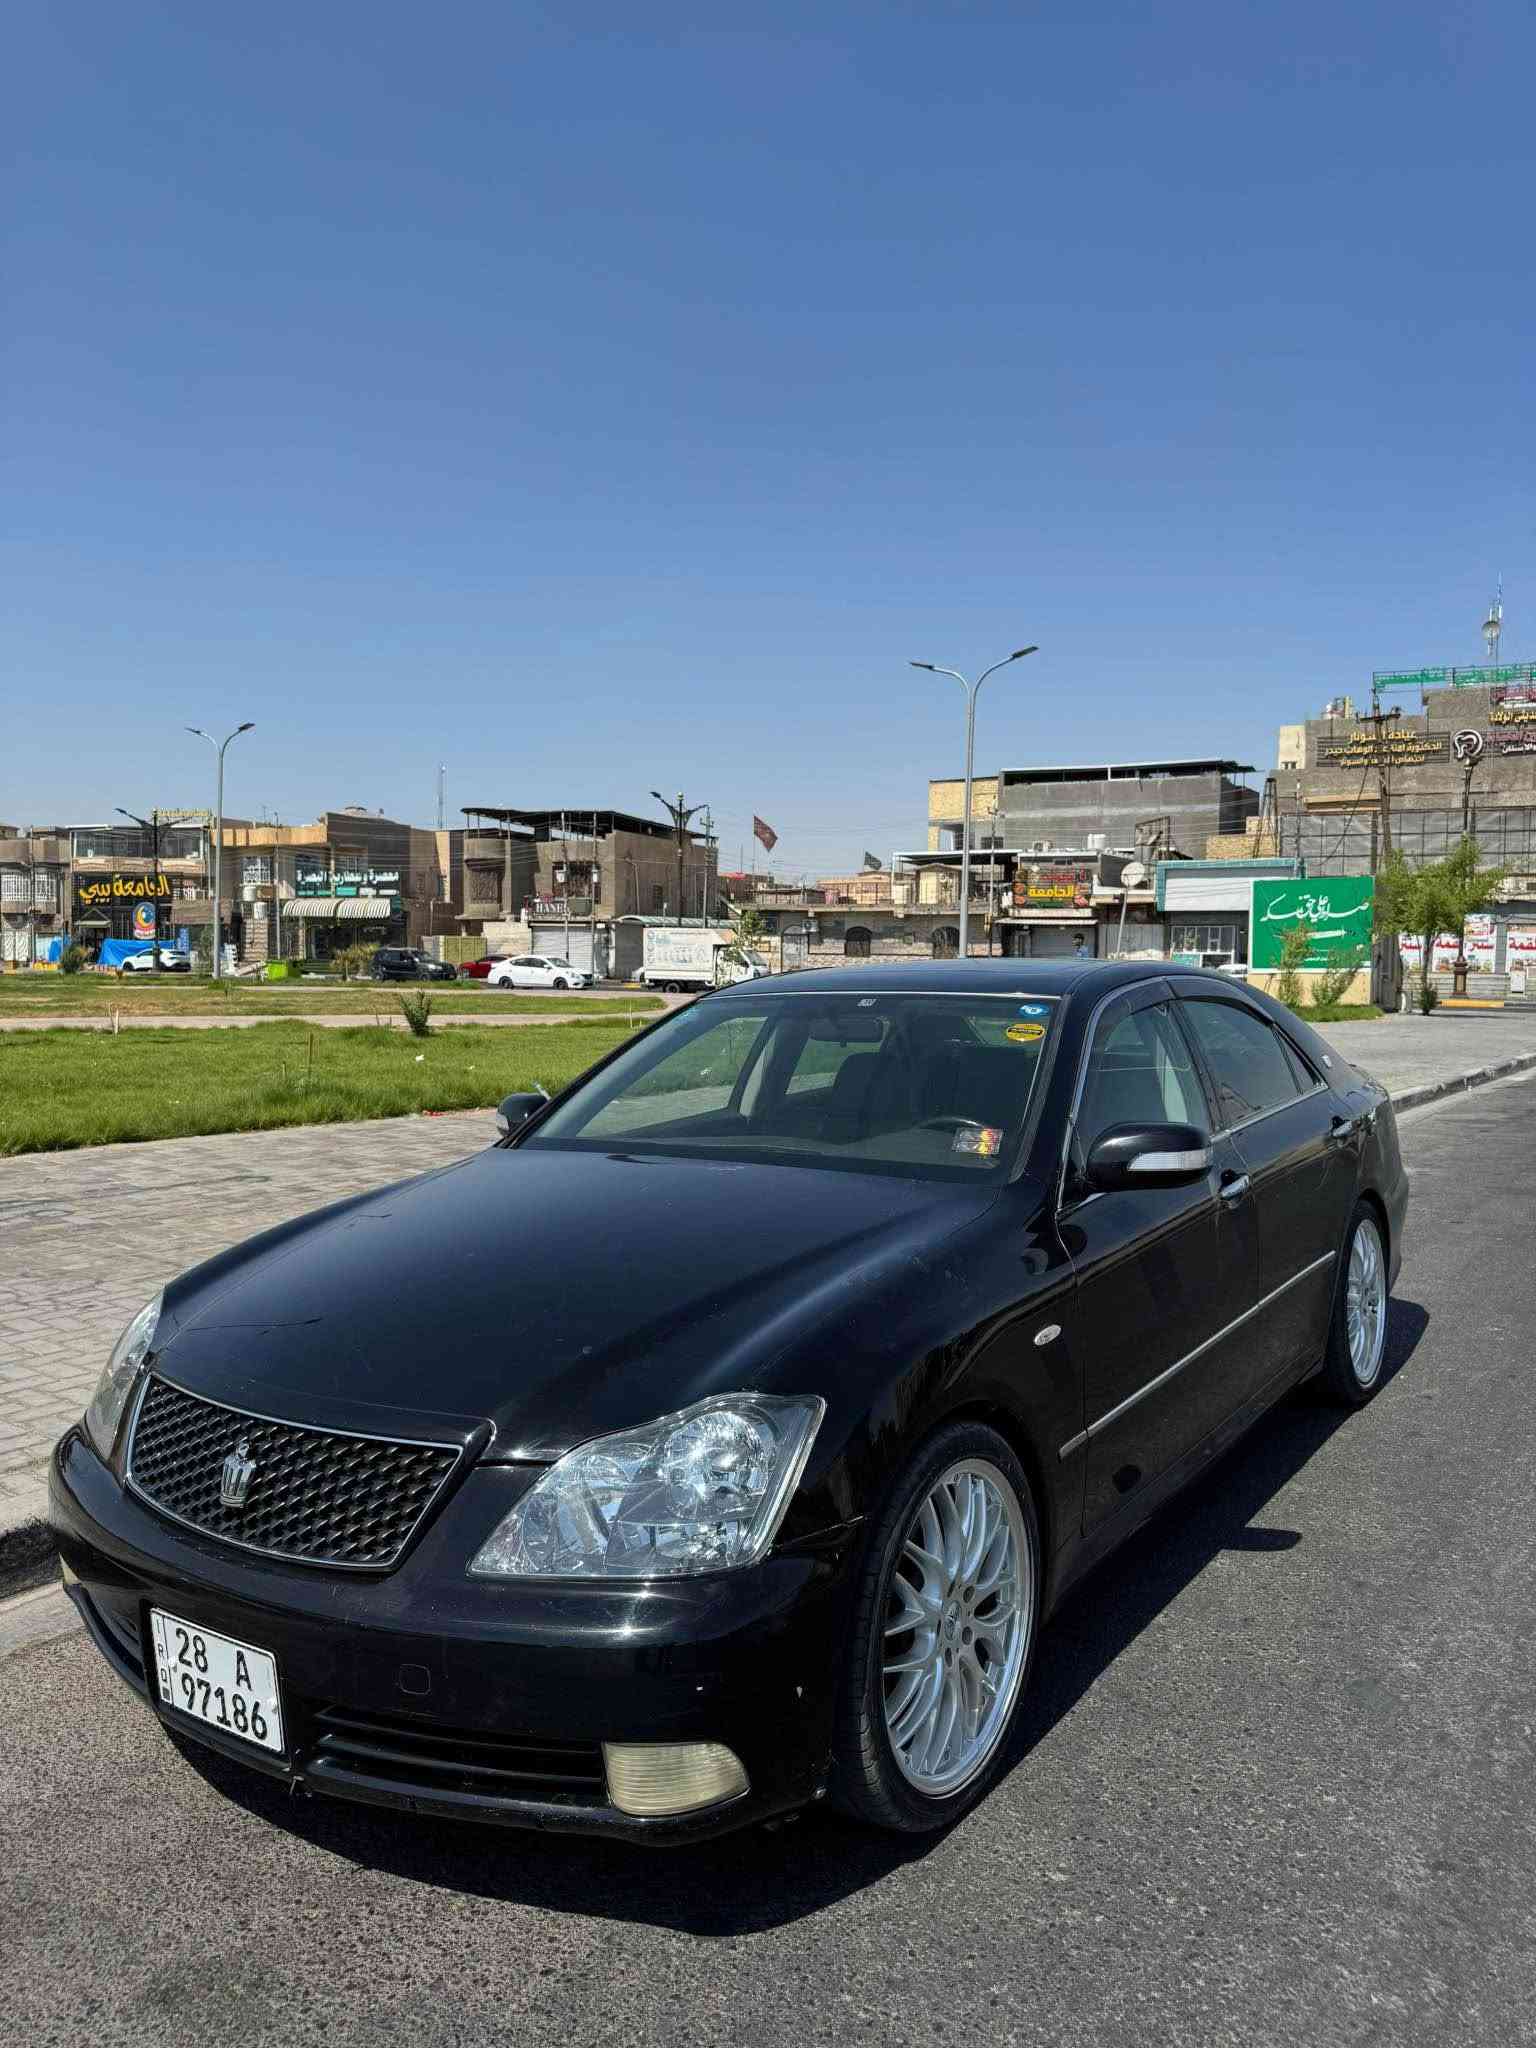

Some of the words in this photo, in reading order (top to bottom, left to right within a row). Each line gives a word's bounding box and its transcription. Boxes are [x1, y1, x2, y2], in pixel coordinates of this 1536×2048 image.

[175, 1627, 209, 1673] 28
[235, 1649, 252, 1692] A
[181, 1672, 268, 1741] 97186
